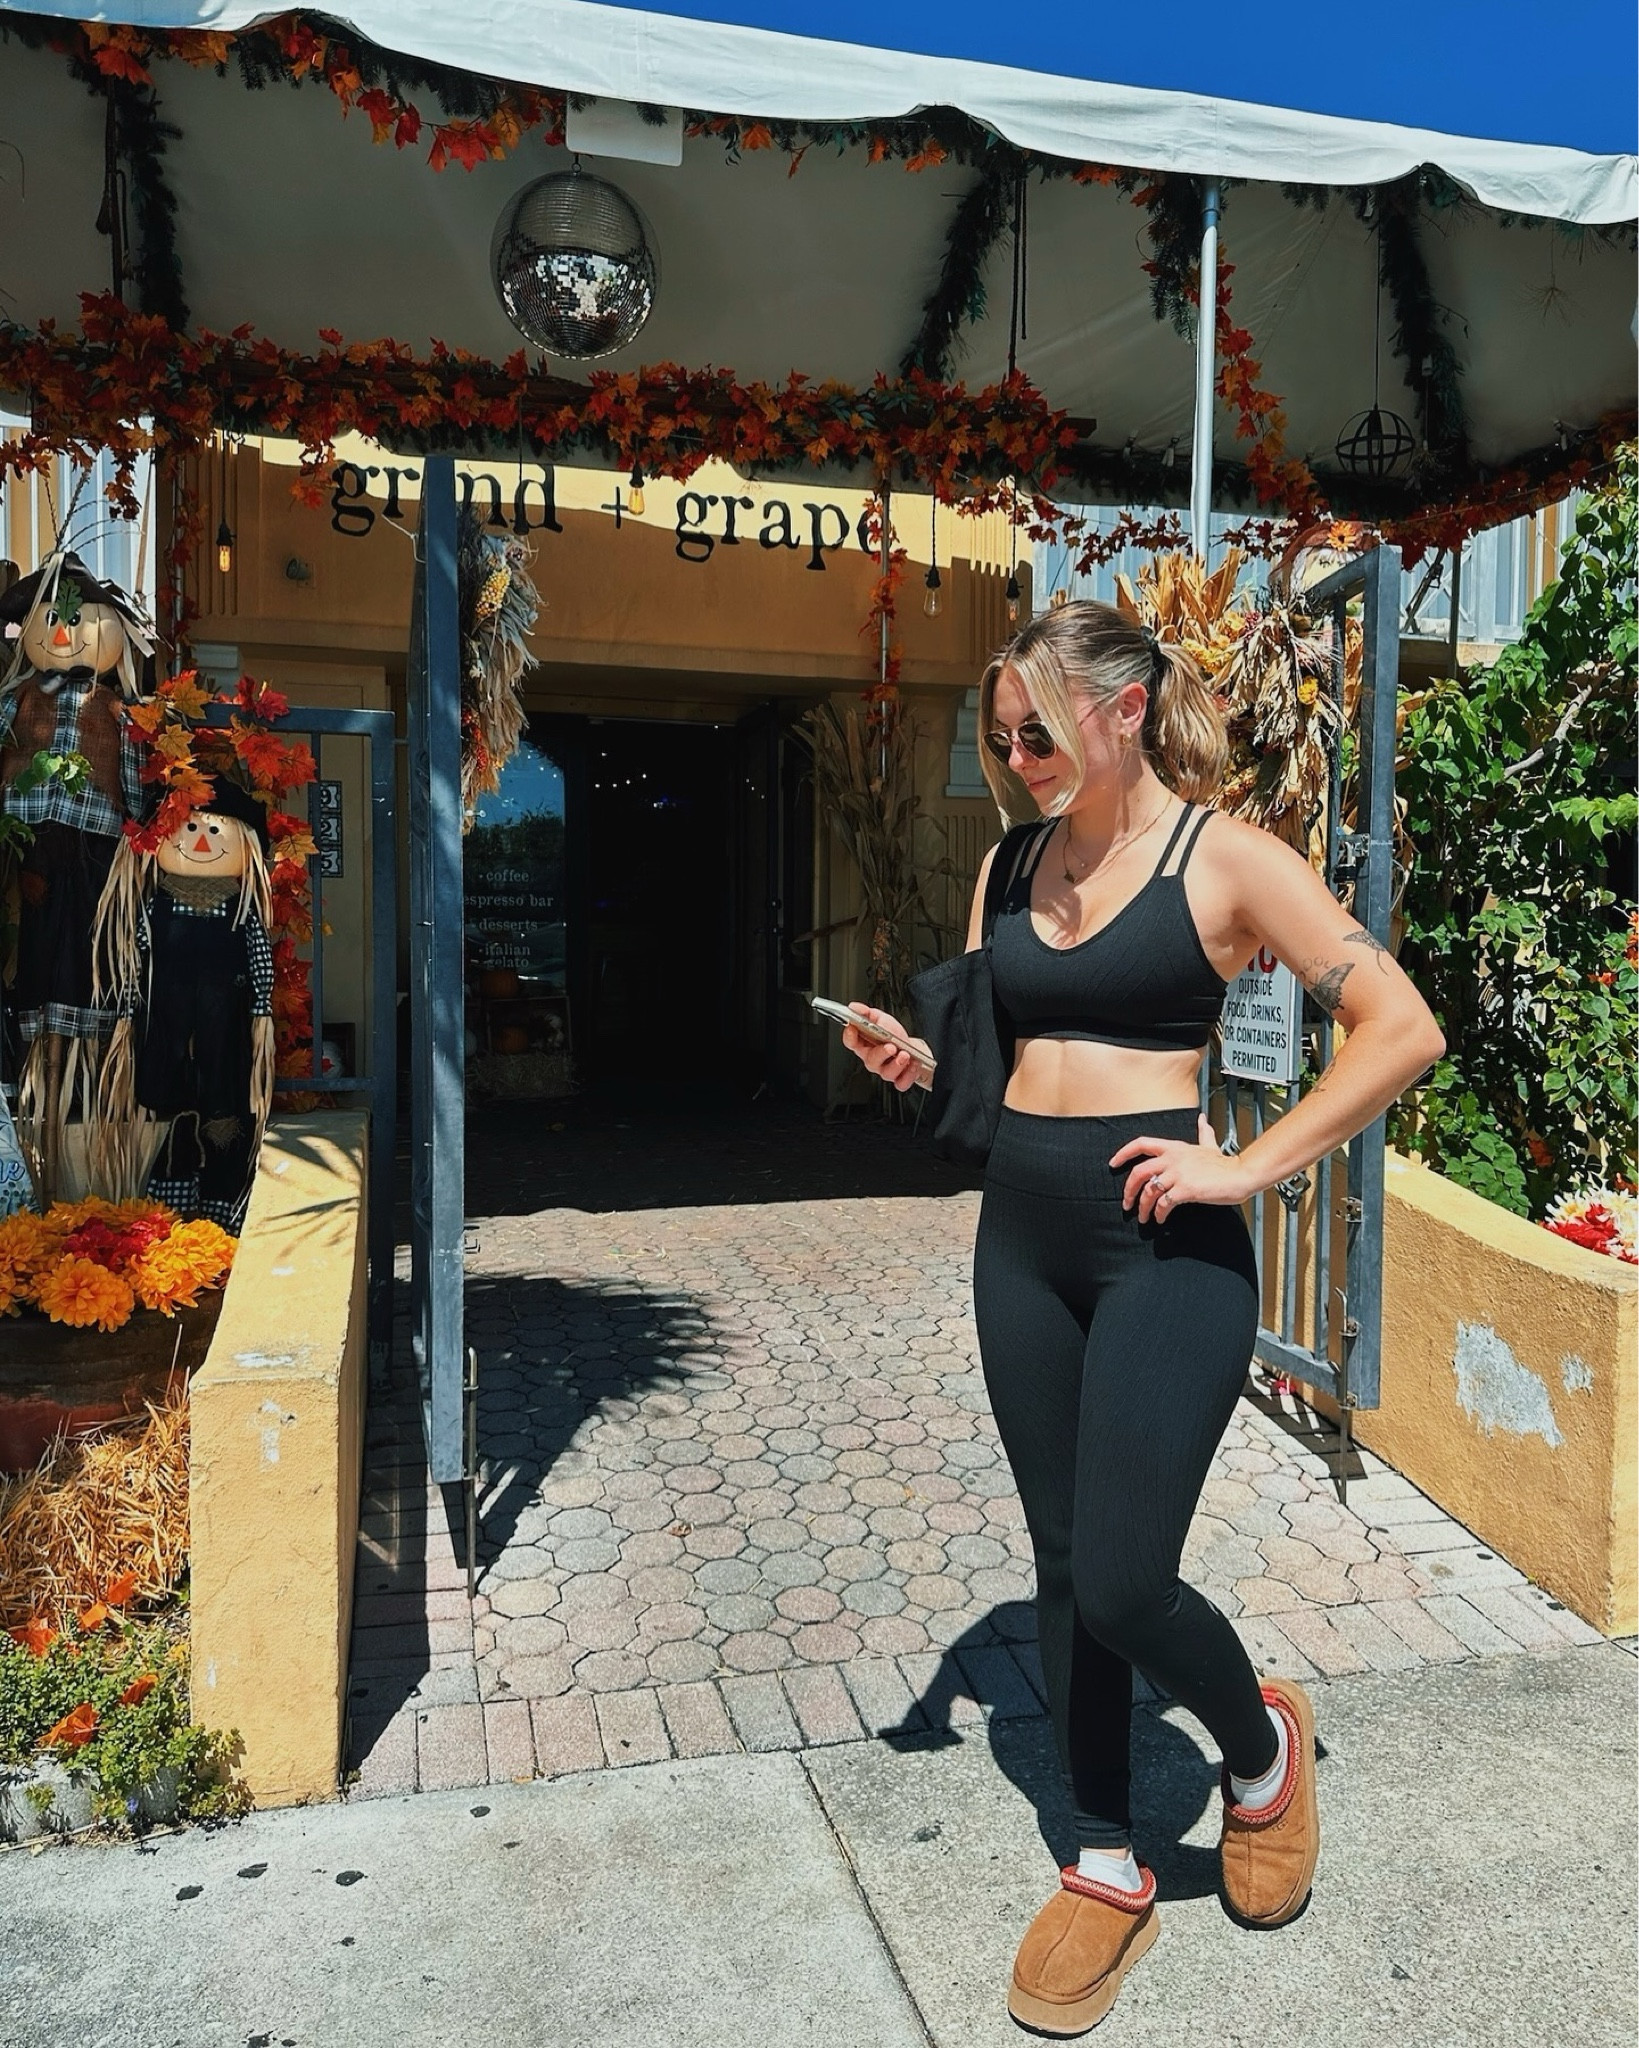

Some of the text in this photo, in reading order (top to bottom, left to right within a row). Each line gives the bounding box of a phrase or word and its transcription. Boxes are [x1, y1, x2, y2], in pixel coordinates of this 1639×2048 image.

[331, 461, 563, 537] grnd
[486, 869, 529, 882] coffee
[529, 893, 554, 907] bar
[479, 918, 538, 931] desserts
[485, 942, 531, 956] italian
[1247, 944, 1278, 974] O
[1238, 978, 1273, 997] OUTSIDE
[1227, 1001, 1284, 1025] FOOD, DRINKS,
[1224, 1024, 1287, 1049] OR CONTAINERS
[1232, 1050, 1277, 1073] PERMITTED
